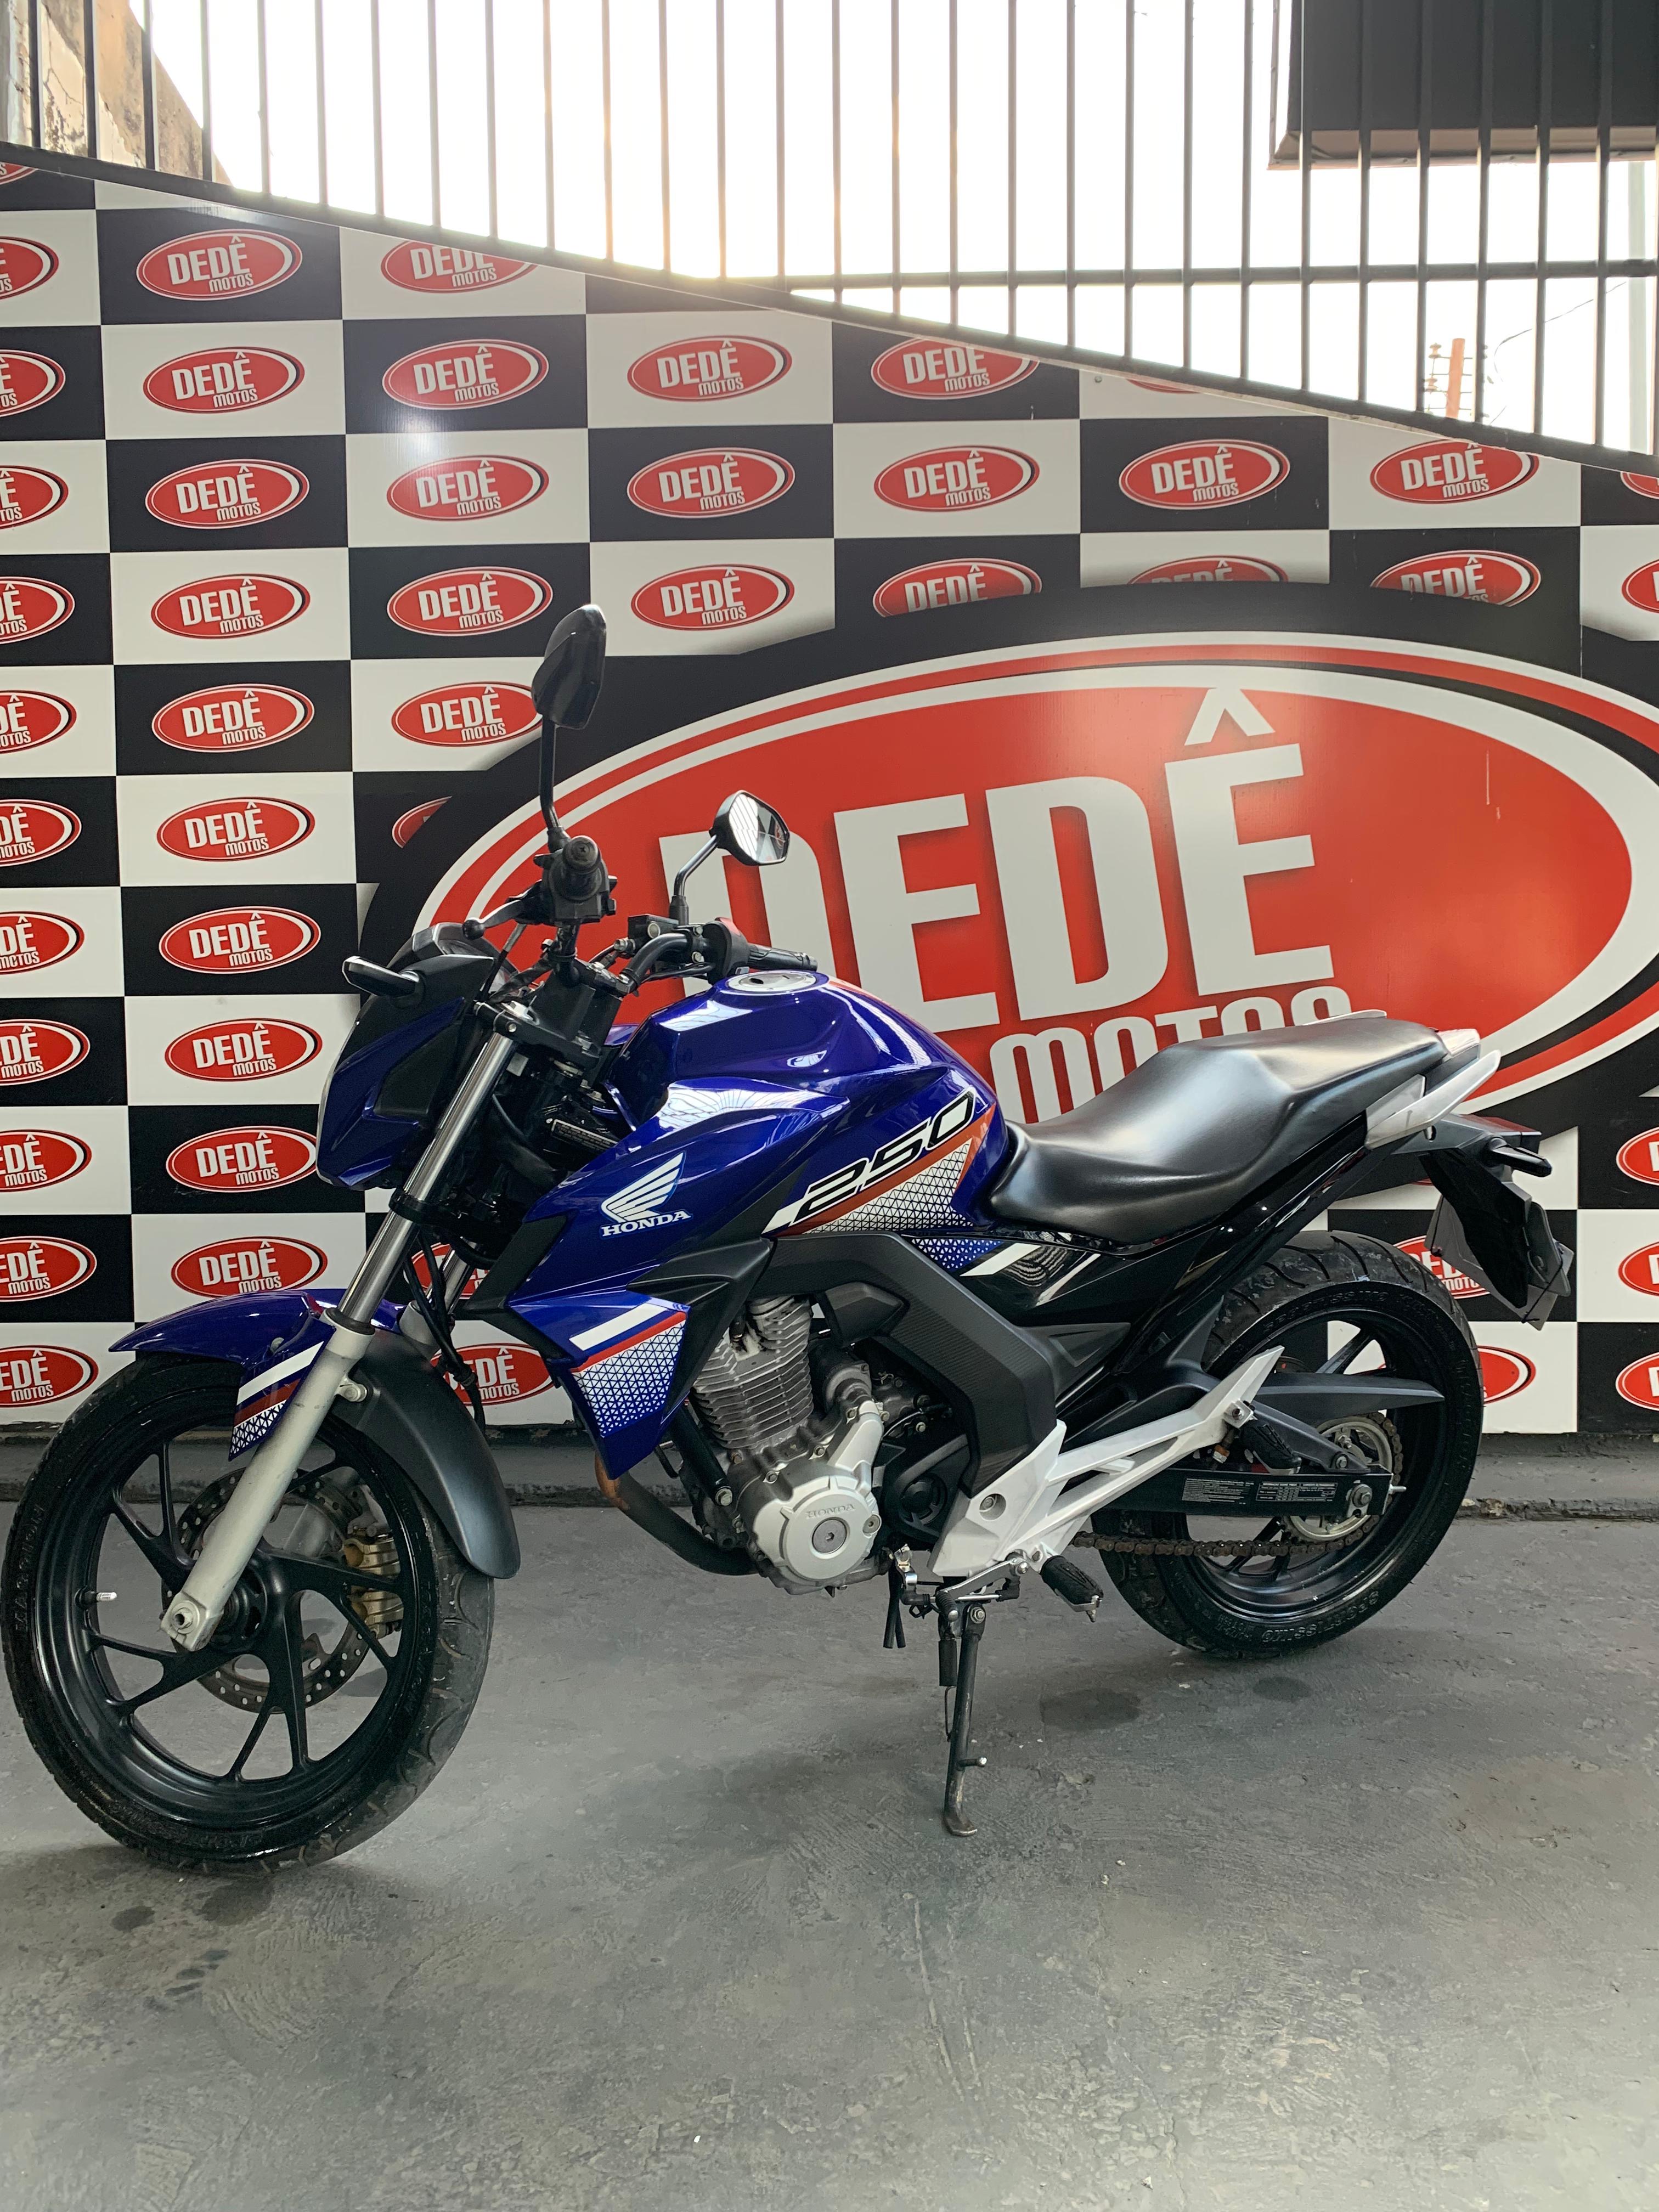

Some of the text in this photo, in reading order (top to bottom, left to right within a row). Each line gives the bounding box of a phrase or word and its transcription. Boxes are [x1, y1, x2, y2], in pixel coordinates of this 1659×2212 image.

[167, 235, 250, 284] DEDÊ
[208, 273, 253, 292] MOTOS
[452, 268, 497, 287] MOTOS
[172, 351, 254, 399] DEDÊ
[414, 345, 496, 394] DEDÊ
[657, 340, 740, 388] DEDÊ
[454, 383, 499, 402] MOTOS
[698, 377, 743, 396] MOTOS
[945, 373, 990, 392] MOTOS
[213, 388, 258, 407] MOTOS
[658, 454, 741, 503] DEDÊ
[904, 450, 987, 499] DEDÊ
[1152, 445, 1235, 493] DEDÊ
[1400, 442, 1486, 490] DEDÊ
[176, 465, 258, 514] DEDÊ
[416, 459, 498, 508] DEDÊ
[945, 487, 991, 506] MOTOS
[1193, 483, 1239, 501] MOTOS
[1443, 478, 1489, 497] MOTOS
[217, 502, 261, 521] MOTOS
[457, 496, 501, 515] MOTOS
[700, 491, 745, 510] MOTOS
[179, 578, 261, 625] DEDÊ
[418, 572, 500, 620] DEDÊ
[661, 569, 743, 617] DEDÊ
[905, 565, 988, 612] DEDÊ
[220, 615, 264, 634] MOTOS
[459, 610, 504, 628] MOTOS
[702, 606, 747, 625] MOTOS
[182, 690, 263, 737] DEDÊ
[420, 686, 503, 733] DEDÊ
[0, 731, 31, 747] OTOS
[222, 726, 266, 744] MOTOS
[461, 723, 506, 741] MOTOS
[0, 805, 32, 845] DÊ
[184, 802, 266, 848] DEDÊ
[225, 837, 269, 856] MOTOS
[658, 689, 1333, 1032] DEDÊ
[0, 915, 36, 956] DÊ
[189, 912, 270, 959] DEDÊ
[229, 948, 273, 966] MOTOS
[0, 1025, 41, 1065] DÊ
[193, 1022, 273, 1069] DEDÊ
[1, 1060, 44, 1079] MOTOS
[232, 1058, 276, 1076] MOTOS
[196, 1132, 276, 1177] DEDÊ
[790, 1086, 977, 1225] 250
[4, 1169, 47, 1186] MOTOS
[235, 1167, 279, 1185] MOTOS
[601, 1209, 691, 1237] HONDA
[0, 1242, 48, 1283] EDÊ
[199, 1240, 279, 1285] DEDÊ
[8, 1277, 51, 1294] MOTOS
[238, 1276, 282, 1294] MOTOS
[0, 1350, 50, 1391] EDÊ
[12, 1385, 54, 1402] MOTOS
[806, 1503, 855, 1519] HONDA
